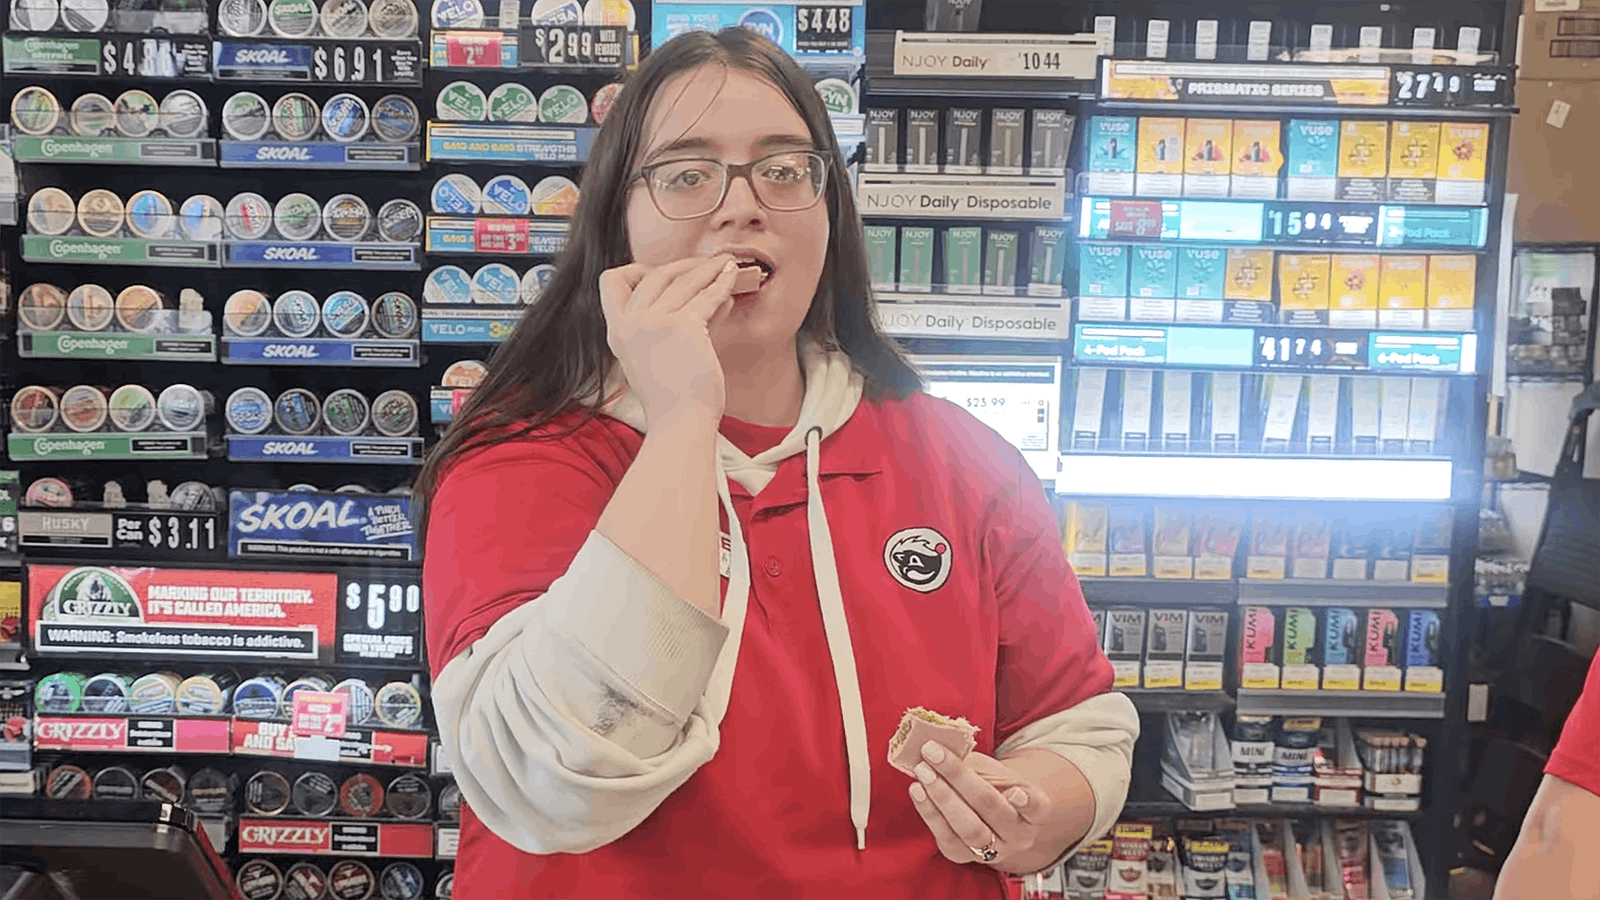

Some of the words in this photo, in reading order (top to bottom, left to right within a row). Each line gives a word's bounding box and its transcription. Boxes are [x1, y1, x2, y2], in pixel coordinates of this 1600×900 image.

[235, 50, 290, 63] SKOAL
[903, 55, 948, 67] NJOY
[953, 56, 988, 71] Daily
[314, 46, 382, 82] $6.91
[1188, 83, 1270, 96] PRISMATIC
[1271, 84, 1324, 97] SERIES
[870, 111, 895, 120] NJOY
[910, 111, 935, 120] NJOY
[953, 111, 978, 120] NJOY
[996, 112, 1021, 120] NJOY
[1036, 113, 1062, 121] NJOY
[41, 139, 113, 157] Copenhagen
[256, 147, 313, 160] SKOAL
[493, 184, 526, 211] VELO
[867, 195, 916, 207] NJOY
[920, 195, 959, 211] Daily
[967, 195, 1051, 211] Disposable
[867, 229, 893, 238] NJOY
[906, 231, 930, 239] NJOY
[953, 230, 978, 239] NJOY
[990, 233, 1015, 241] NJOY
[1038, 229, 1064, 239] NJOY
[50, 239, 122, 259] Copenhagen
[263, 247, 319, 260] SKOAL
[430, 324, 465, 335] VELO
[926, 316, 964, 330] Daily
[972, 316, 1056, 332] Disposable
[57, 335, 129, 355] Copenhagen
[263, 345, 319, 357] SKOAL
[34, 437, 105, 456] Copenhagen
[262, 442, 318, 455] SKOAL
[237, 500, 359, 532] SKOAL
[42, 516, 90, 530] HUSKY
[118, 519, 142, 529] Per
[116, 528, 143, 540] Can
[149, 516, 214, 549] $3.11
[148, 586, 208, 600] MARKING
[210, 587, 237, 600] OUR
[239, 588, 313, 604] TERRITORY.
[62, 600, 131, 616] GRIZZLY
[148, 601, 173, 614] IT'S
[174, 602, 223, 616] CALLED
[223, 603, 287, 618] AMERICA.
[1112, 614, 1142, 623] VIM
[1153, 613, 1183, 622] VIM
[1195, 615, 1224, 624] VIM
[47, 629, 114, 642] WARNING:
[116, 630, 180, 645] Smokeless
[182, 633, 231, 646] tobacco
[233, 635, 244, 646] is
[246, 635, 305, 648] addictive.
[37, 723, 124, 741] GRIZZLY
[242, 826, 328, 845] GRIZZLY
